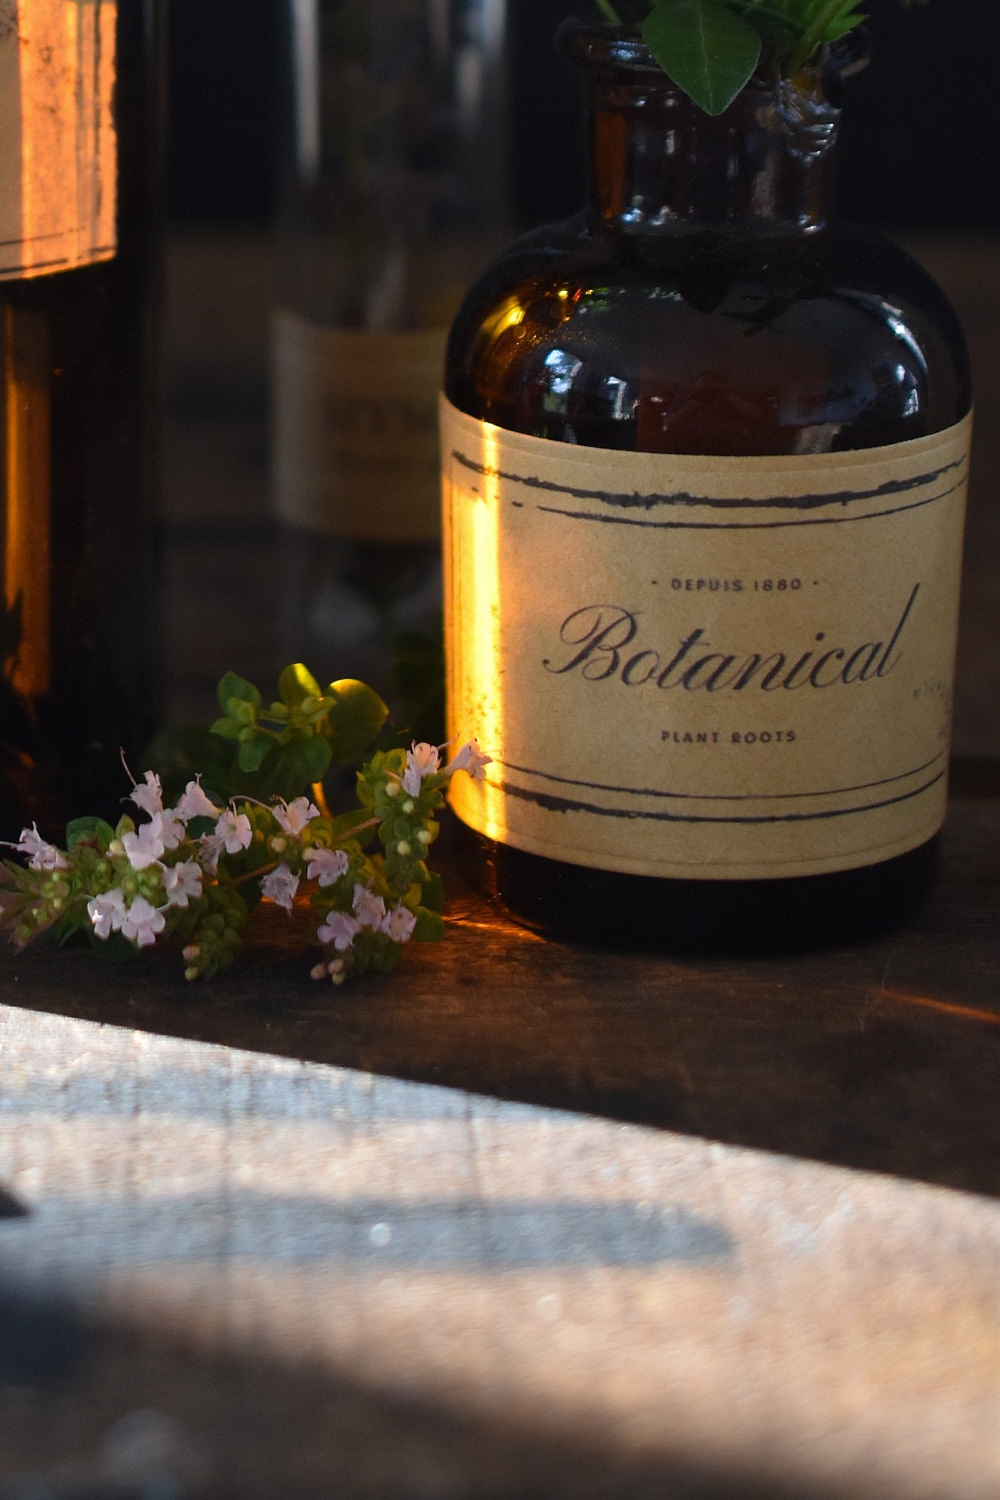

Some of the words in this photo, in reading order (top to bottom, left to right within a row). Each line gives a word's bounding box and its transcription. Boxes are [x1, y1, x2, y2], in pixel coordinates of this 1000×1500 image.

[670, 577, 744, 592] DEPUIS
[754, 577, 802, 592] 1880
[542, 582, 921, 693] Botanical
[661, 730, 719, 744] PLANT
[731, 730, 796, 744] ROOTS
